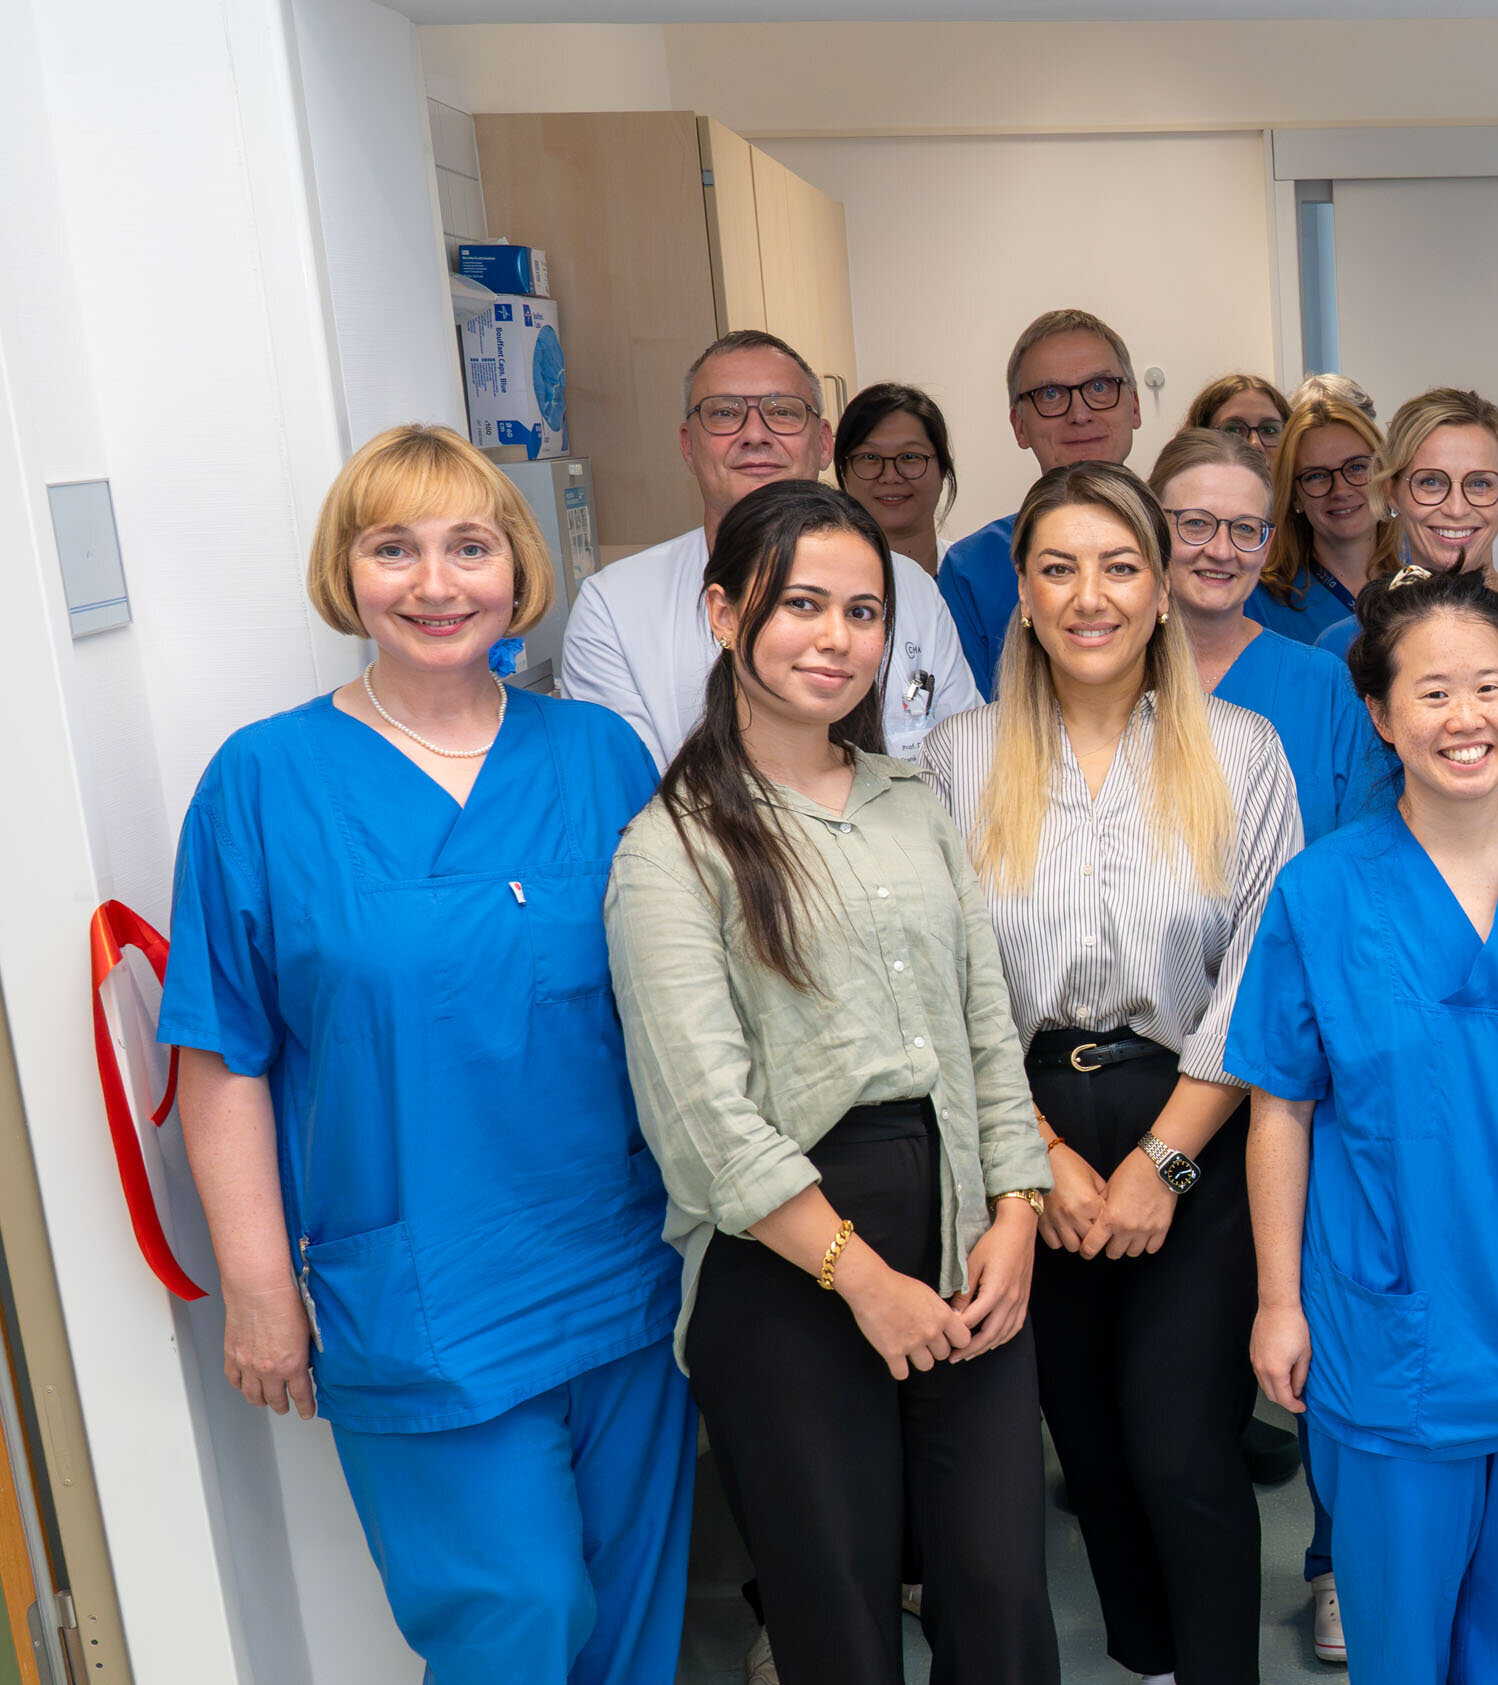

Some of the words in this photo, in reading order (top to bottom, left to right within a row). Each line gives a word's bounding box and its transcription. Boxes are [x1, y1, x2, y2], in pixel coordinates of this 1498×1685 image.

[496, 327, 505, 358] Bouffant
[500, 378, 508, 394] Blue
[902, 742, 917, 751] Prof.
